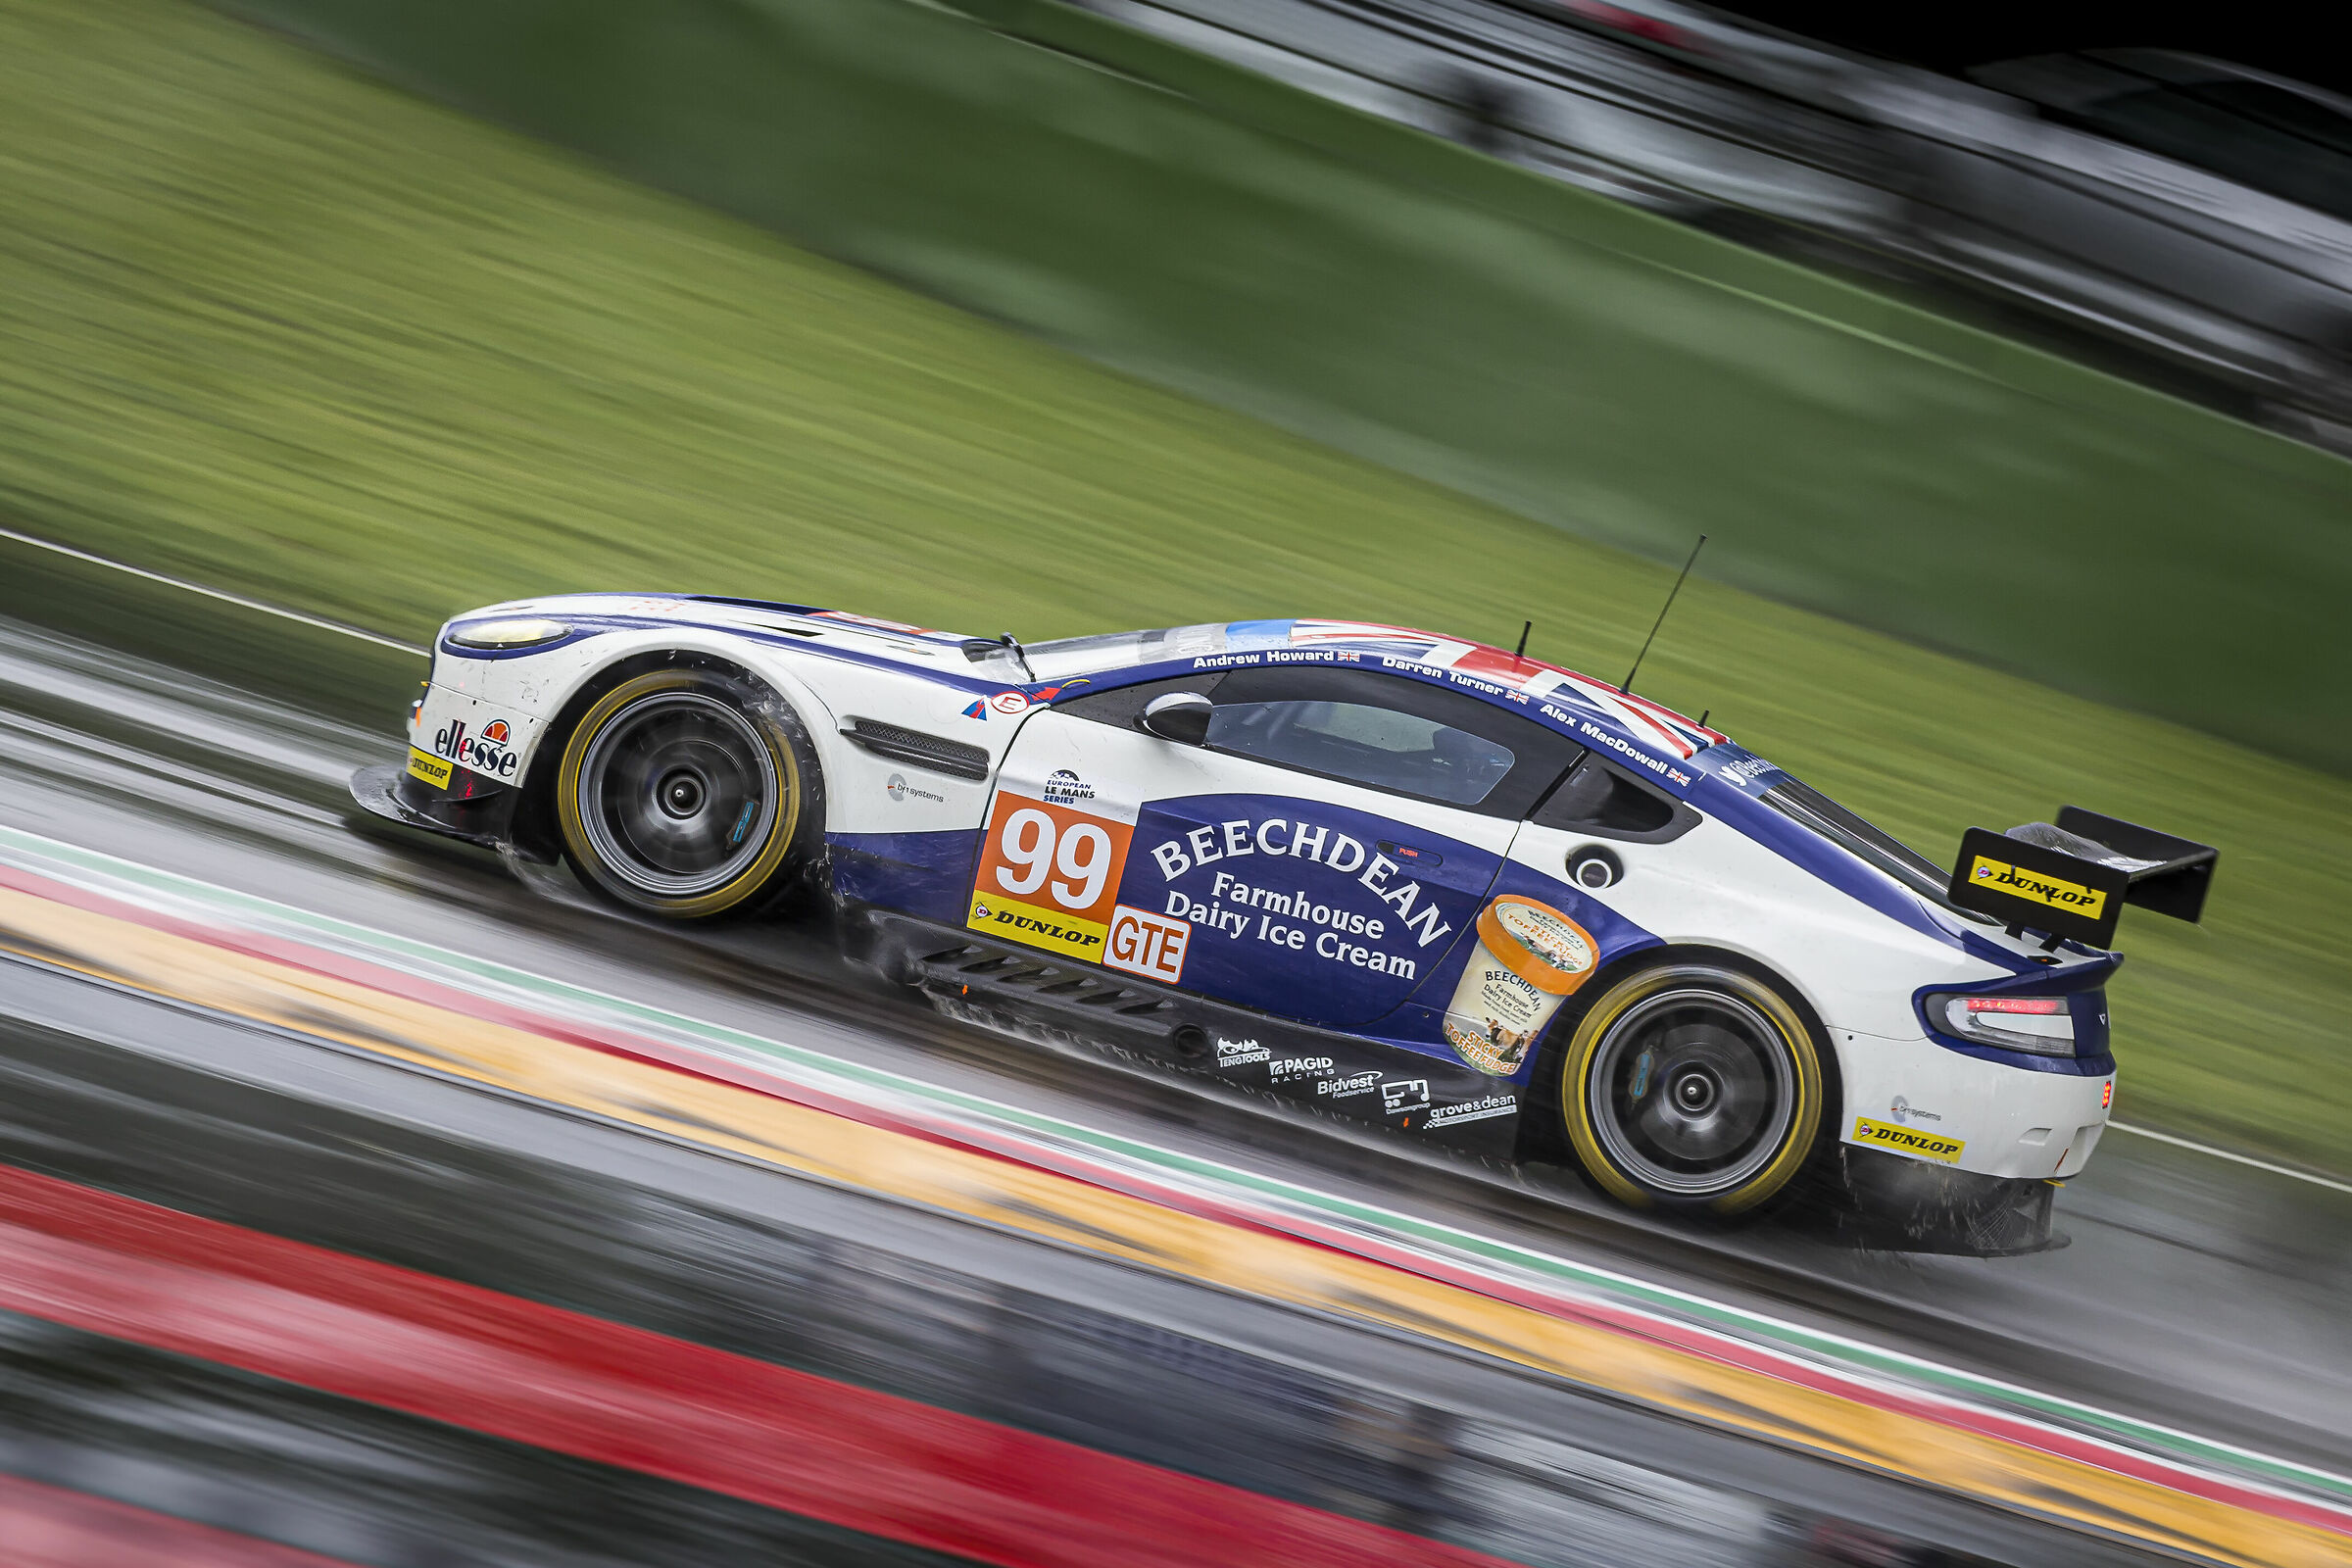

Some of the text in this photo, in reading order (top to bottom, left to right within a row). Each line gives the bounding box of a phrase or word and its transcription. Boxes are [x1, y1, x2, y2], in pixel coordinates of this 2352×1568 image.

[1193, 650, 1335, 668] Andrew Howard
[1382, 656, 1503, 696] Darren Turner
[999, 696, 1021, 710] E
[435, 718, 517, 777] ellesse
[1540, 703, 1670, 775] Alex MacDowall
[412, 758, 448, 779] DUNLOP
[1045, 785, 1096, 800] LE MANS
[1046, 779, 1092, 790] EUROPEAN
[1043, 795, 1075, 805] SERIES
[996, 808, 1112, 909] 99
[1151, 818, 1452, 948] BEECHDEAN
[1994, 871, 2096, 907] DUNLOP
[1211, 871, 1385, 940] Farmhouse
[994, 910, 1101, 946] DUNLOP
[1165, 890, 1417, 980] Dairy Ice Cream
[1111, 915, 1184, 973] GTE
[1484, 984, 1501, 1001] Dairy
[1502, 998, 1512, 1007] Ice
[1485, 970, 1541, 1011] BEECHDEAN
[1495, 983, 1529, 1008] Farmhouse
[1446, 1022, 1516, 1075] TOFFEE FUDGE
[1467, 1030, 1505, 1058] STICKY
[1271, 1068, 1335, 1084] RACING
[1285, 1056, 1334, 1073] PAGID
[1317, 1074, 1374, 1095] Bidvest
[1333, 1086, 1375, 1099] Foodservice
[1431, 1095, 1516, 1119] grove&dean
[1873, 1128, 1959, 1155] DUNLOP
